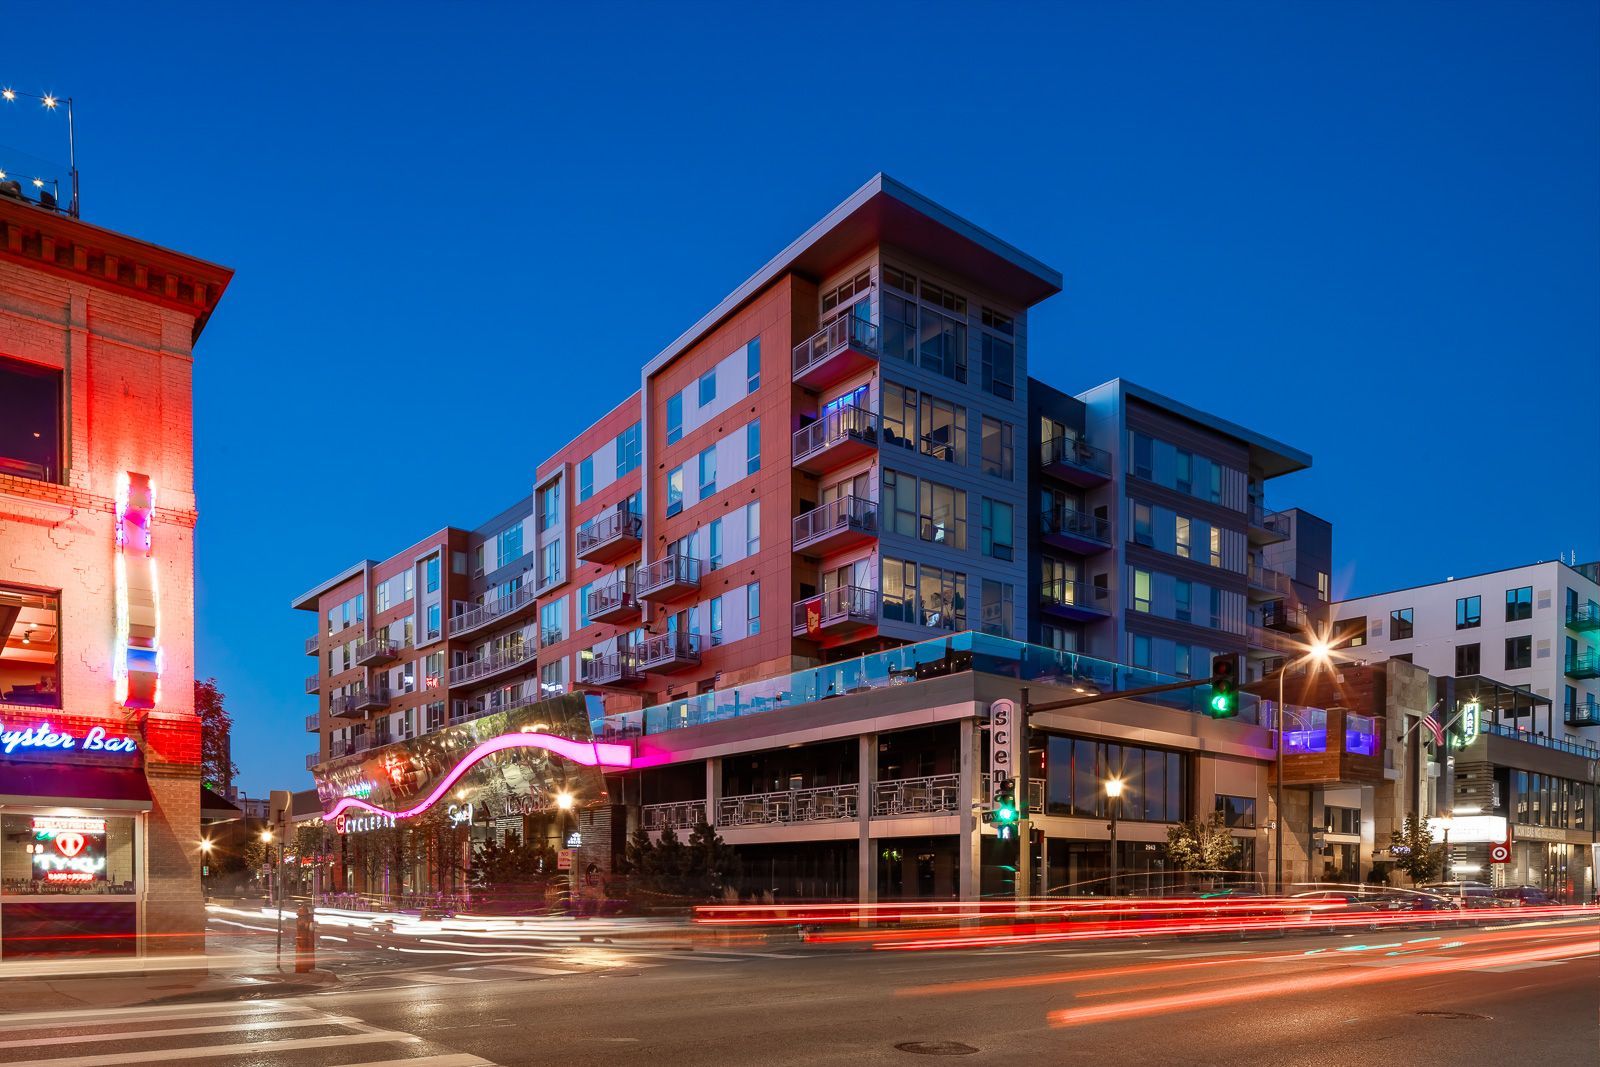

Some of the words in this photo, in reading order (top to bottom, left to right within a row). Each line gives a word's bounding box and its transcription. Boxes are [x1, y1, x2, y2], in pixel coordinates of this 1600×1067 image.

[0, 722, 75, 753] yster
[82, 726, 137, 752] Bar
[345, 814, 396, 833] CYCLEBAR
